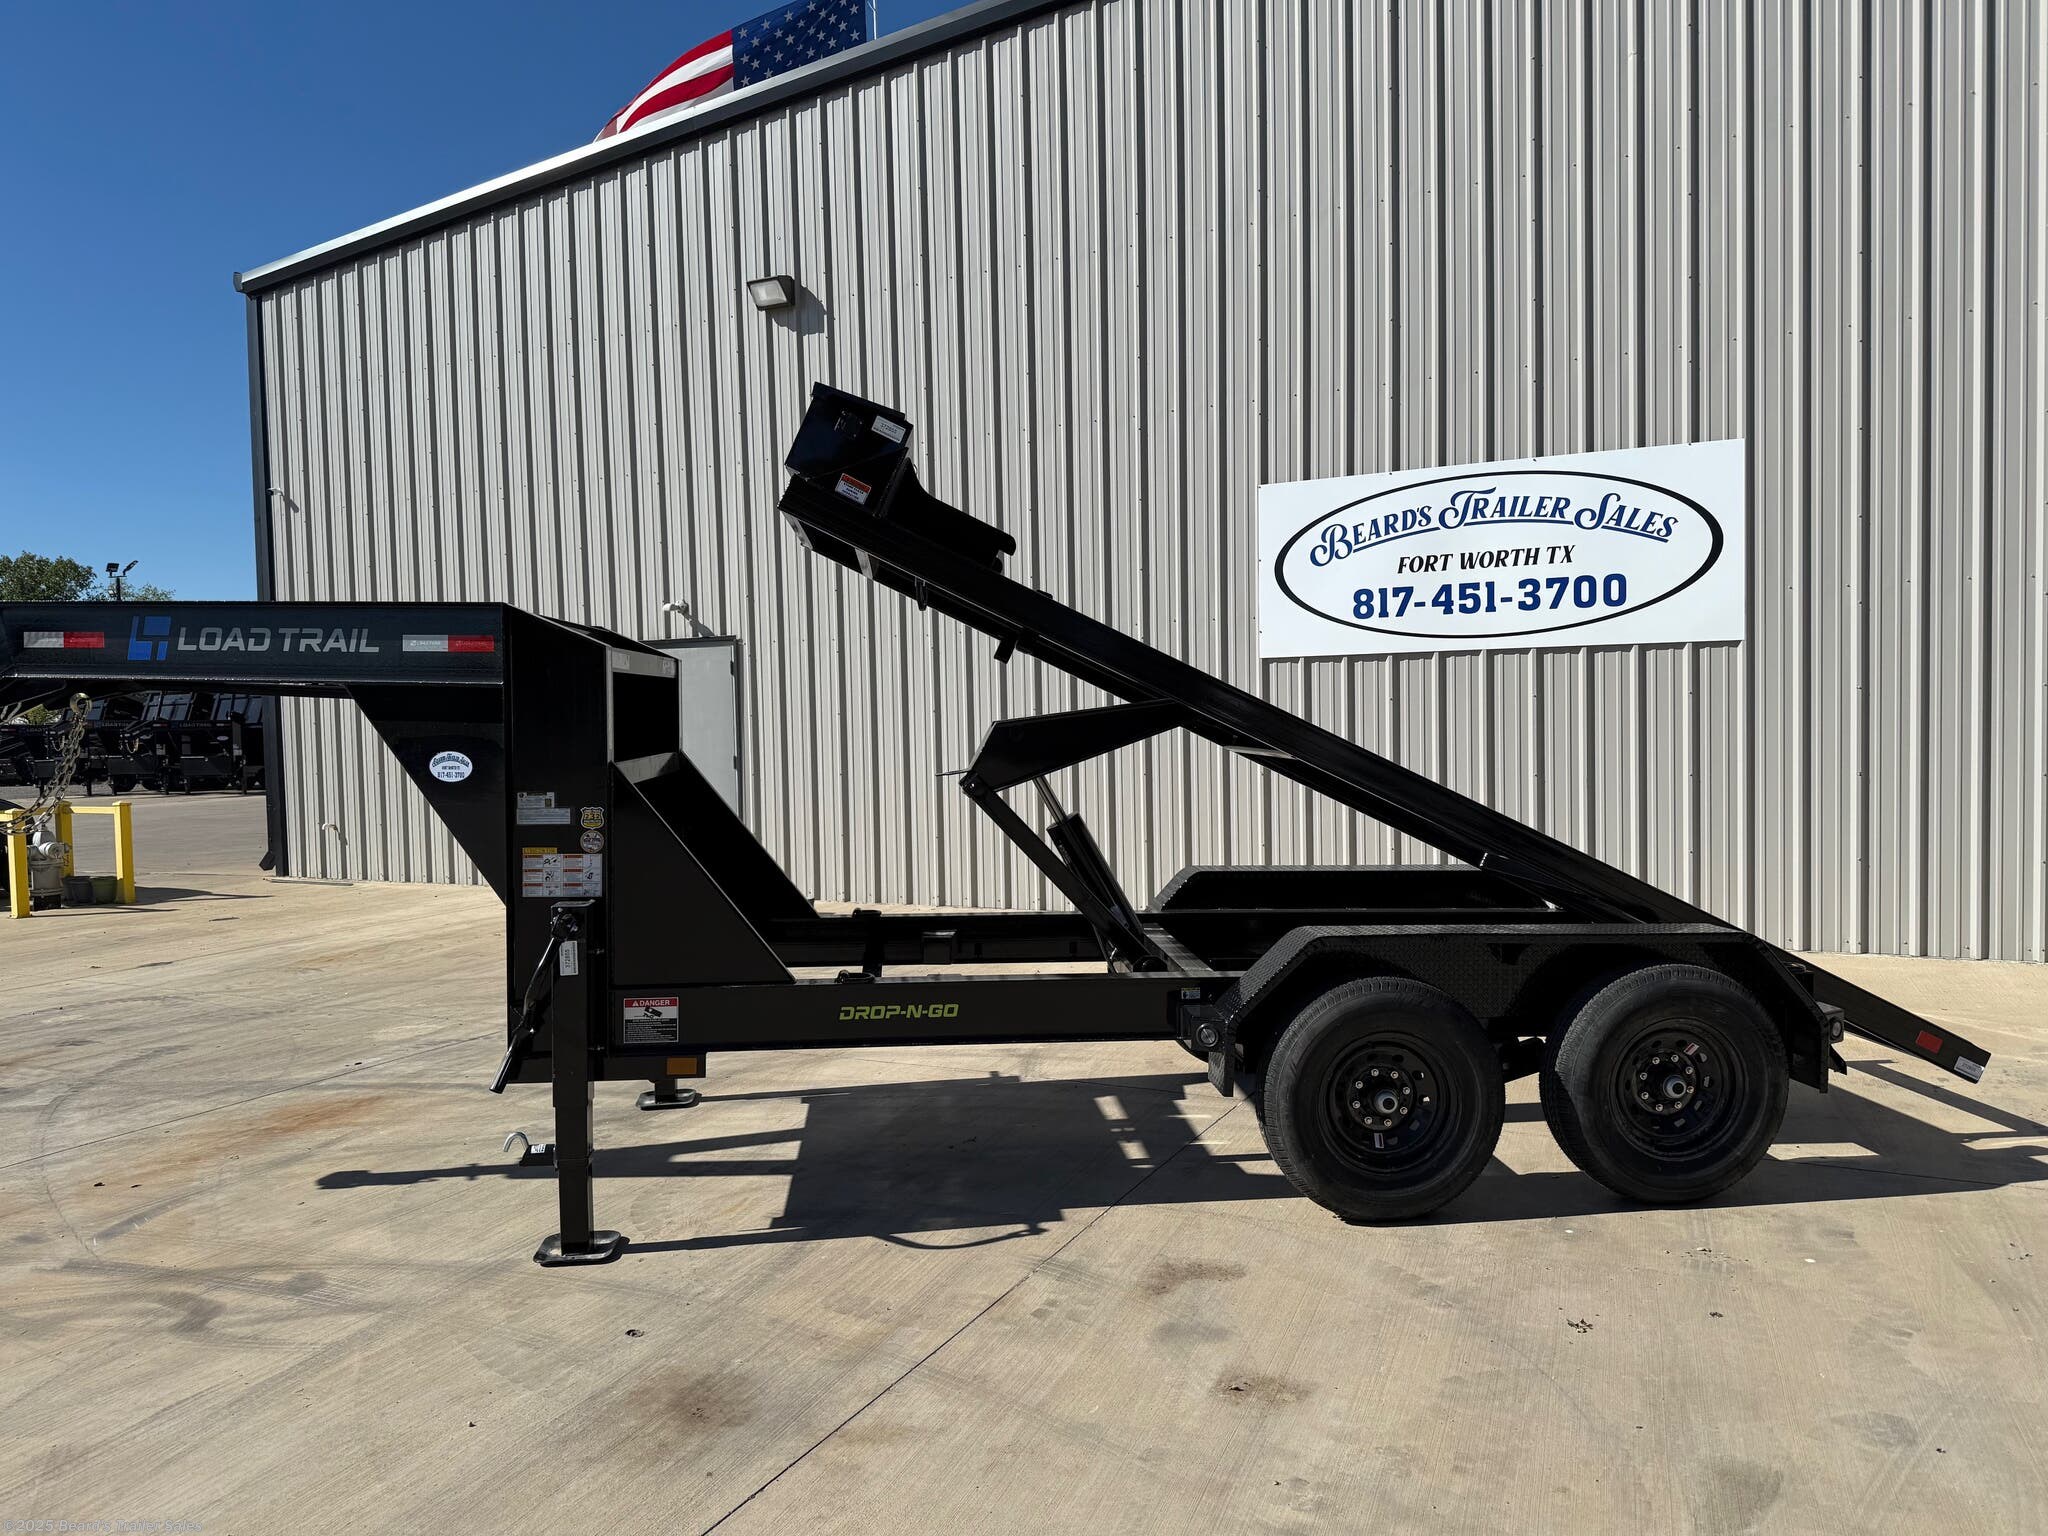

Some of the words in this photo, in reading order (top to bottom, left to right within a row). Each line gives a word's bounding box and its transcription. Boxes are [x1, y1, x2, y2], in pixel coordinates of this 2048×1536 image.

[1310, 506, 1432, 567] BEARD'S
[1438, 487, 1571, 530] TRAILER
[1574, 493, 1679, 538] SALES
[1398, 553, 1453, 574] FORT
[1460, 547, 1540, 570] WORTH
[1546, 545, 1576, 565] TX
[1353, 573, 1627, 619] 817-451-3700
[177, 627, 271, 651] LOAD
[278, 628, 379, 653] TRAIL
[640, 999, 670, 1007] DANGER
[840, 1004, 959, 1020] DROP-N-GO
